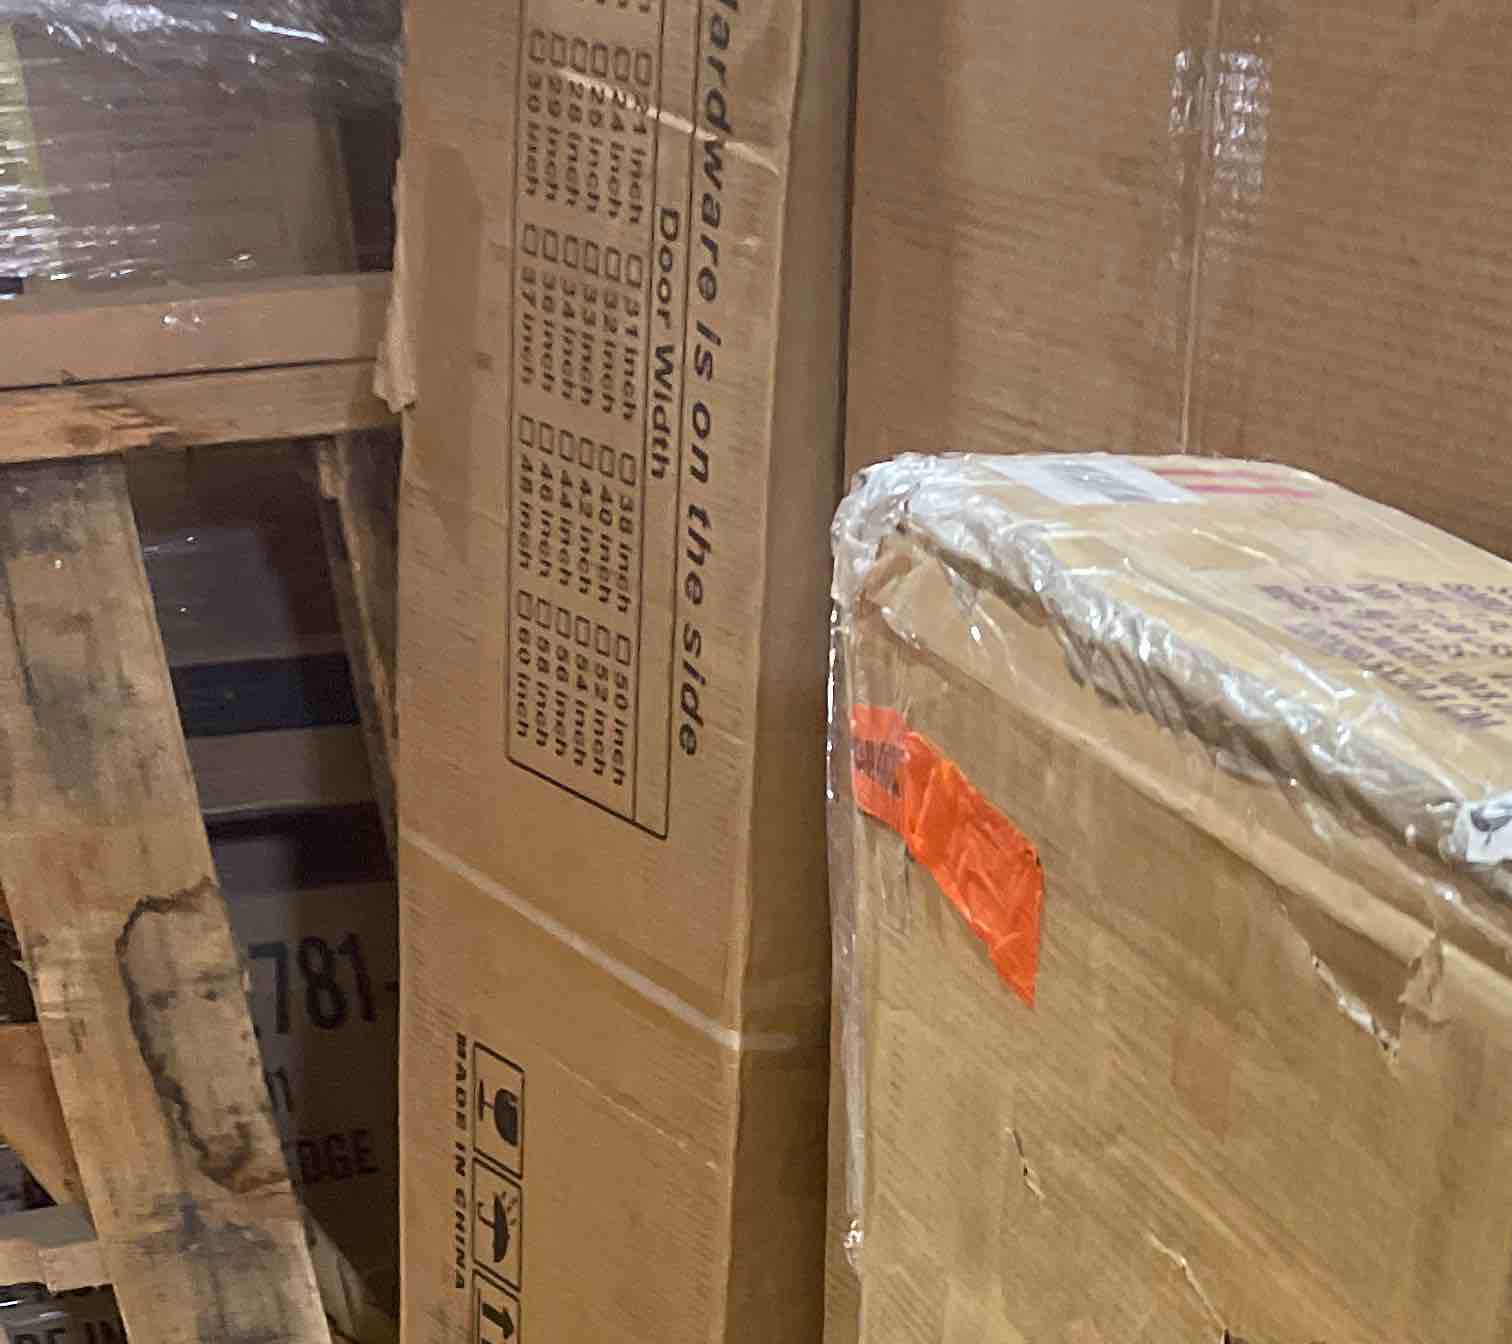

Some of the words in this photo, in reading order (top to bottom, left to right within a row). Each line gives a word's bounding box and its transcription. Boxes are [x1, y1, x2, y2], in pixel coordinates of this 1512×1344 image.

[526, 122, 540, 196] inch
[545, 127, 561, 200] inch
[566, 132, 582, 206] inch
[587, 136, 603, 213] inch
[608, 141, 624, 219] inch
[630, 148, 646, 224] inch
[697, 0, 738, 303] ardware
[657, 207, 680, 329] Door
[521, 312, 535, 385] inch
[541, 319, 555, 393] inch
[562, 326, 576, 400] inch
[581, 332, 595, 406] inch
[601, 340, 616, 414] inch
[623, 347, 638, 421] inch
[694, 319, 722, 381] is
[651, 344, 676, 479] Width
[690, 400, 712, 483] on
[560, 469, 573, 510] 44
[599, 484, 613, 527] 40
[519, 501, 533, 569] inch
[539, 509, 554, 578] inch
[560, 516, 573, 587] inch
[578, 524, 593, 595] inch
[598, 533, 613, 603] inch
[685, 504, 712, 606] the
[617, 542, 633, 614] inch
[517, 671, 531, 738] inch
[535, 680, 549, 747] inch
[555, 690, 568, 758] inch
[679, 624, 707, 756] side
[574, 699, 588, 767] inch
[593, 708, 607, 777] inch
[612, 717, 628, 786] inch
[455, 1032, 468, 1130] MADE
[455, 1142, 467, 1177] IN
[454, 1188, 467, 1290] CHINA
